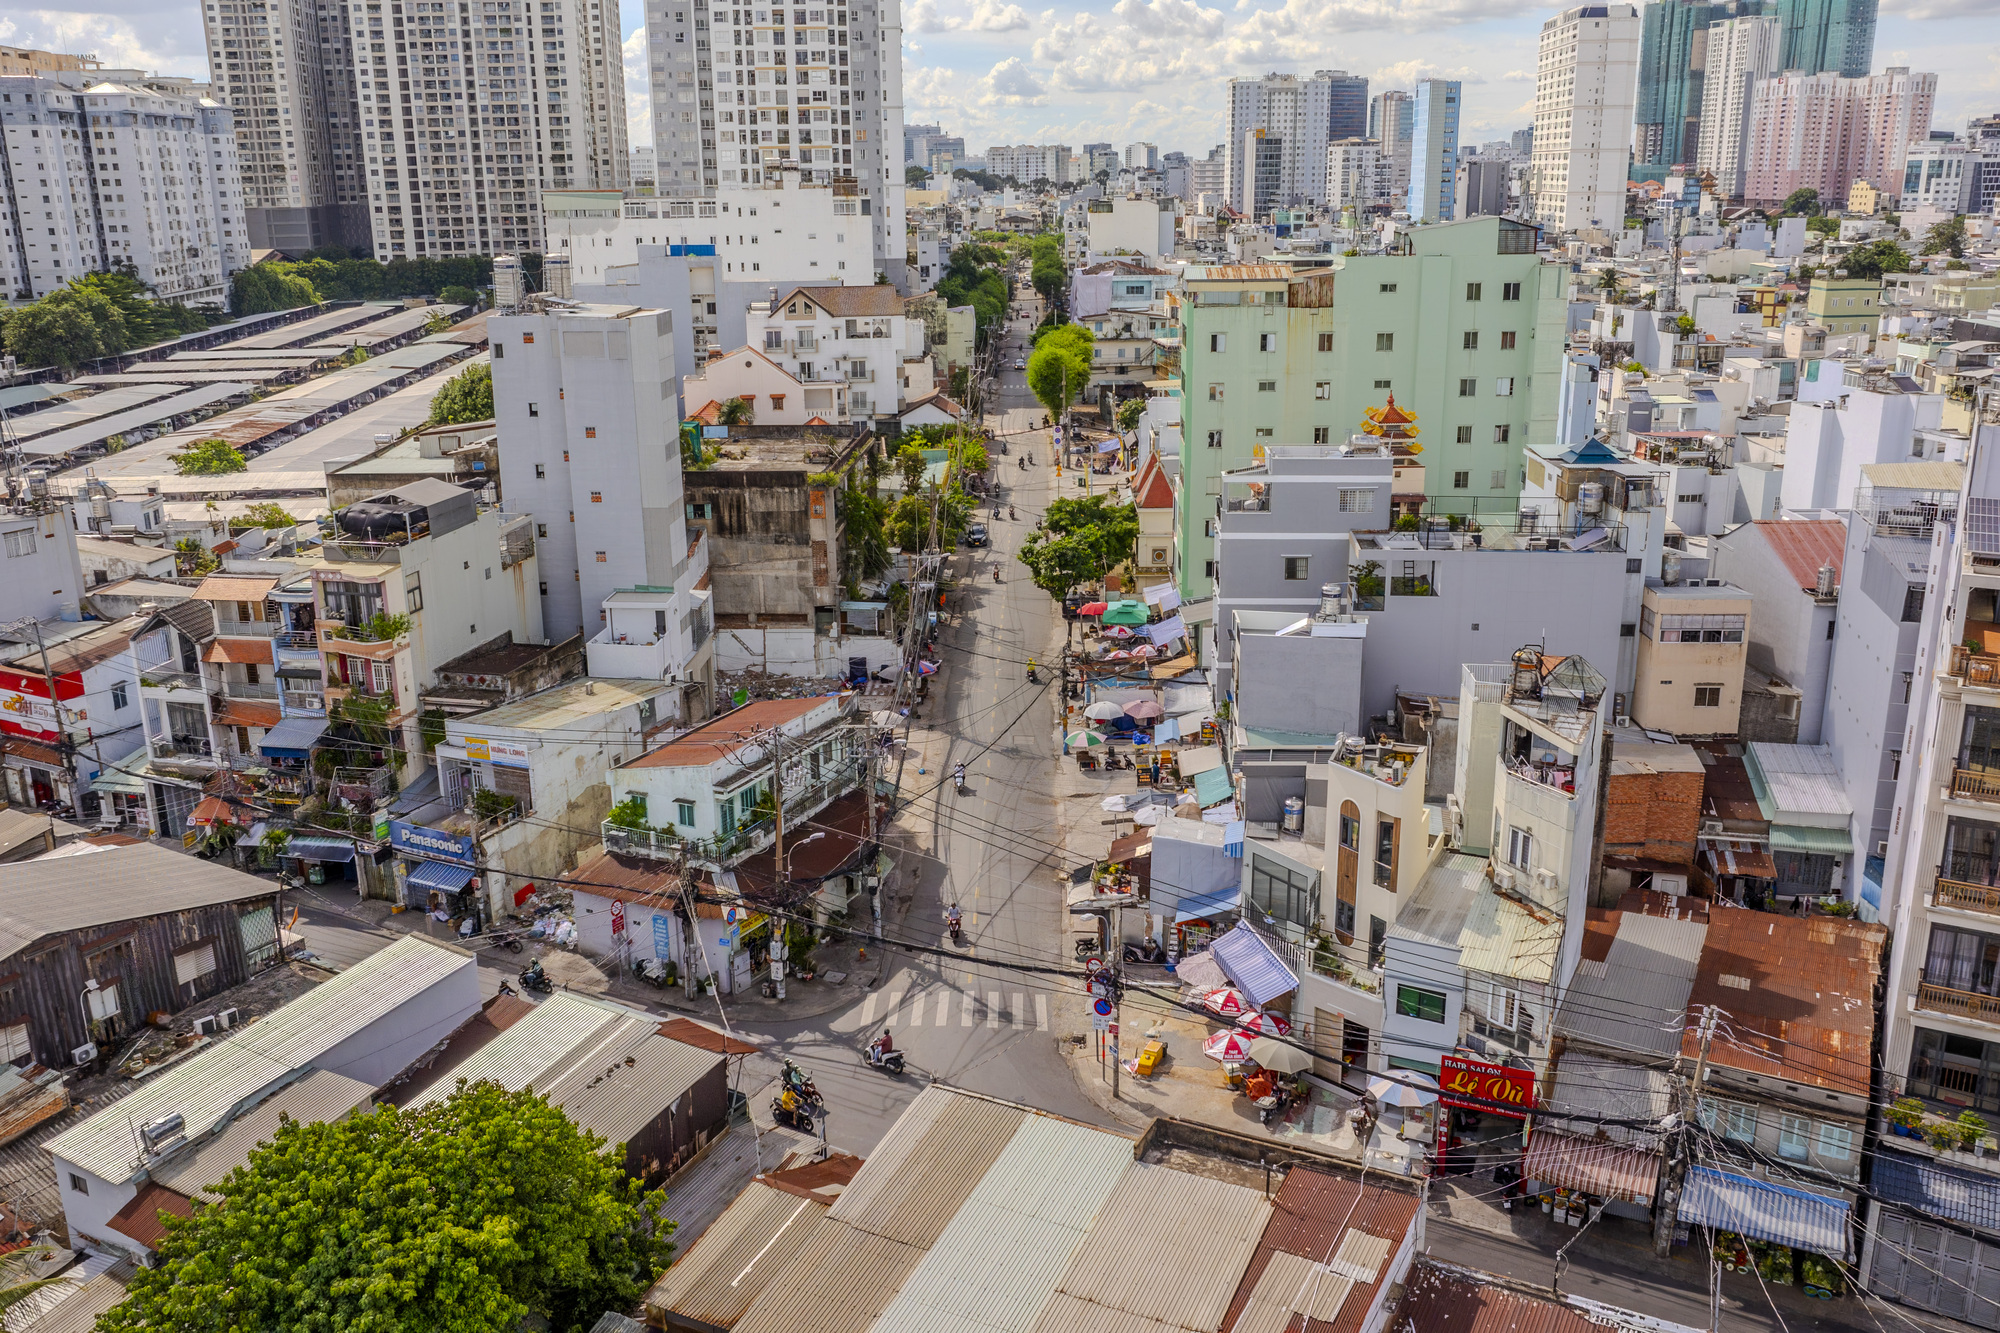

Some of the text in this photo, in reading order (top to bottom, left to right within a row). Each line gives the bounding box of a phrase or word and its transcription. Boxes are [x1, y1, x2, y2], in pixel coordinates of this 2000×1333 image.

[2, 700, 17, 711] GAS
[508, 748, 525, 757] LONG
[401, 828, 463, 854] Panasonic
[1444, 1059, 1501, 1076] HAIR SALON
[1446, 1071, 1526, 1104] Lê Vũ
